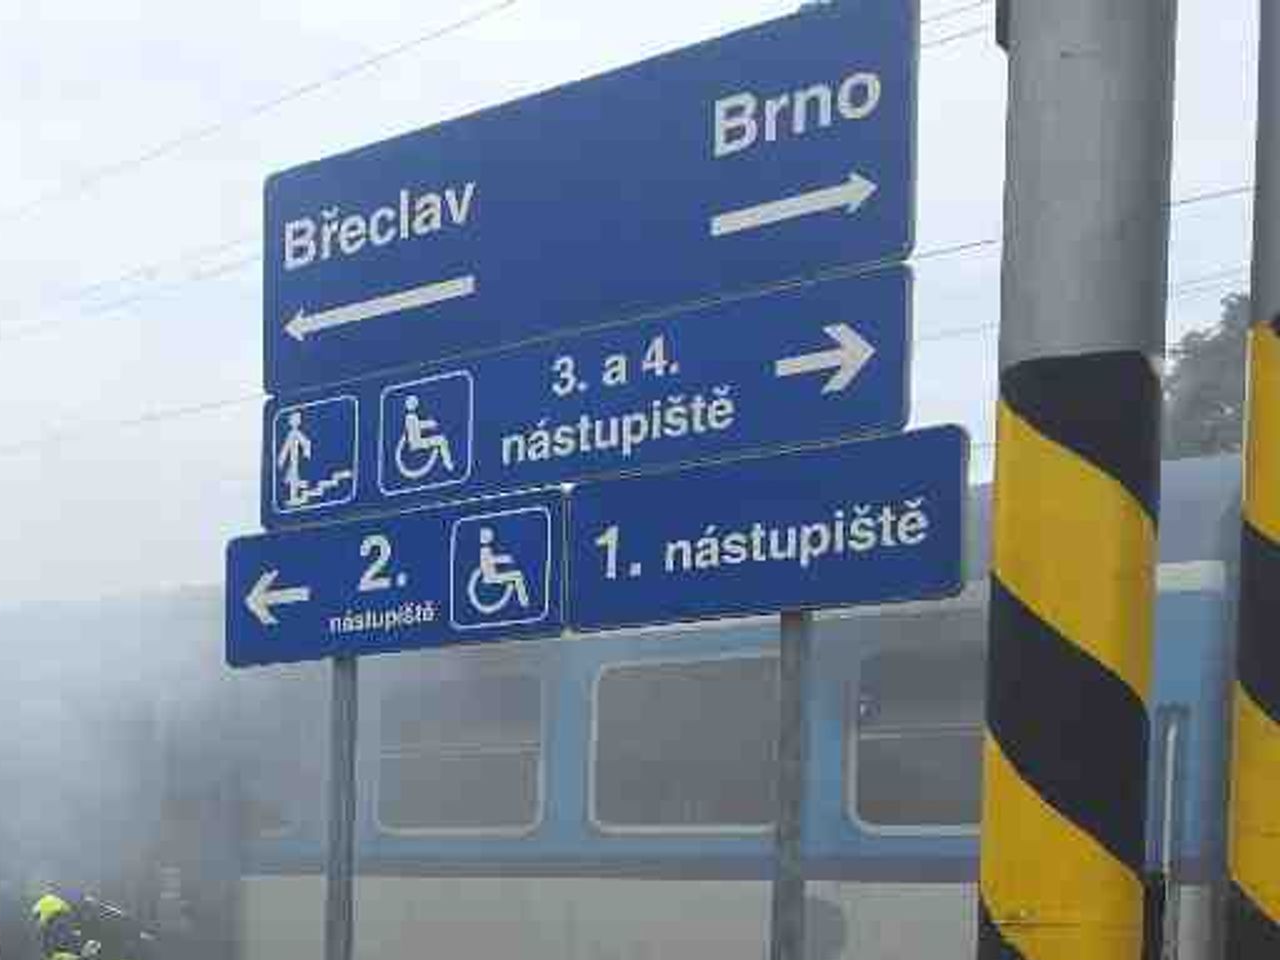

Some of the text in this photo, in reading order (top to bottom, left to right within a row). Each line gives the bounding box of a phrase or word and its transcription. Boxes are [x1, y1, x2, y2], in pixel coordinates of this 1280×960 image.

[714, 72, 881, 156] Brno
[283, 181, 476, 270] Břeclav
[552, 335, 679, 396] 3. a 4.
[502, 387, 734, 466] nástupiště
[358, 535, 406, 592] 2.
[595, 498, 928, 579] 1. nástupiště
[329, 601, 436, 633] nástupiště
